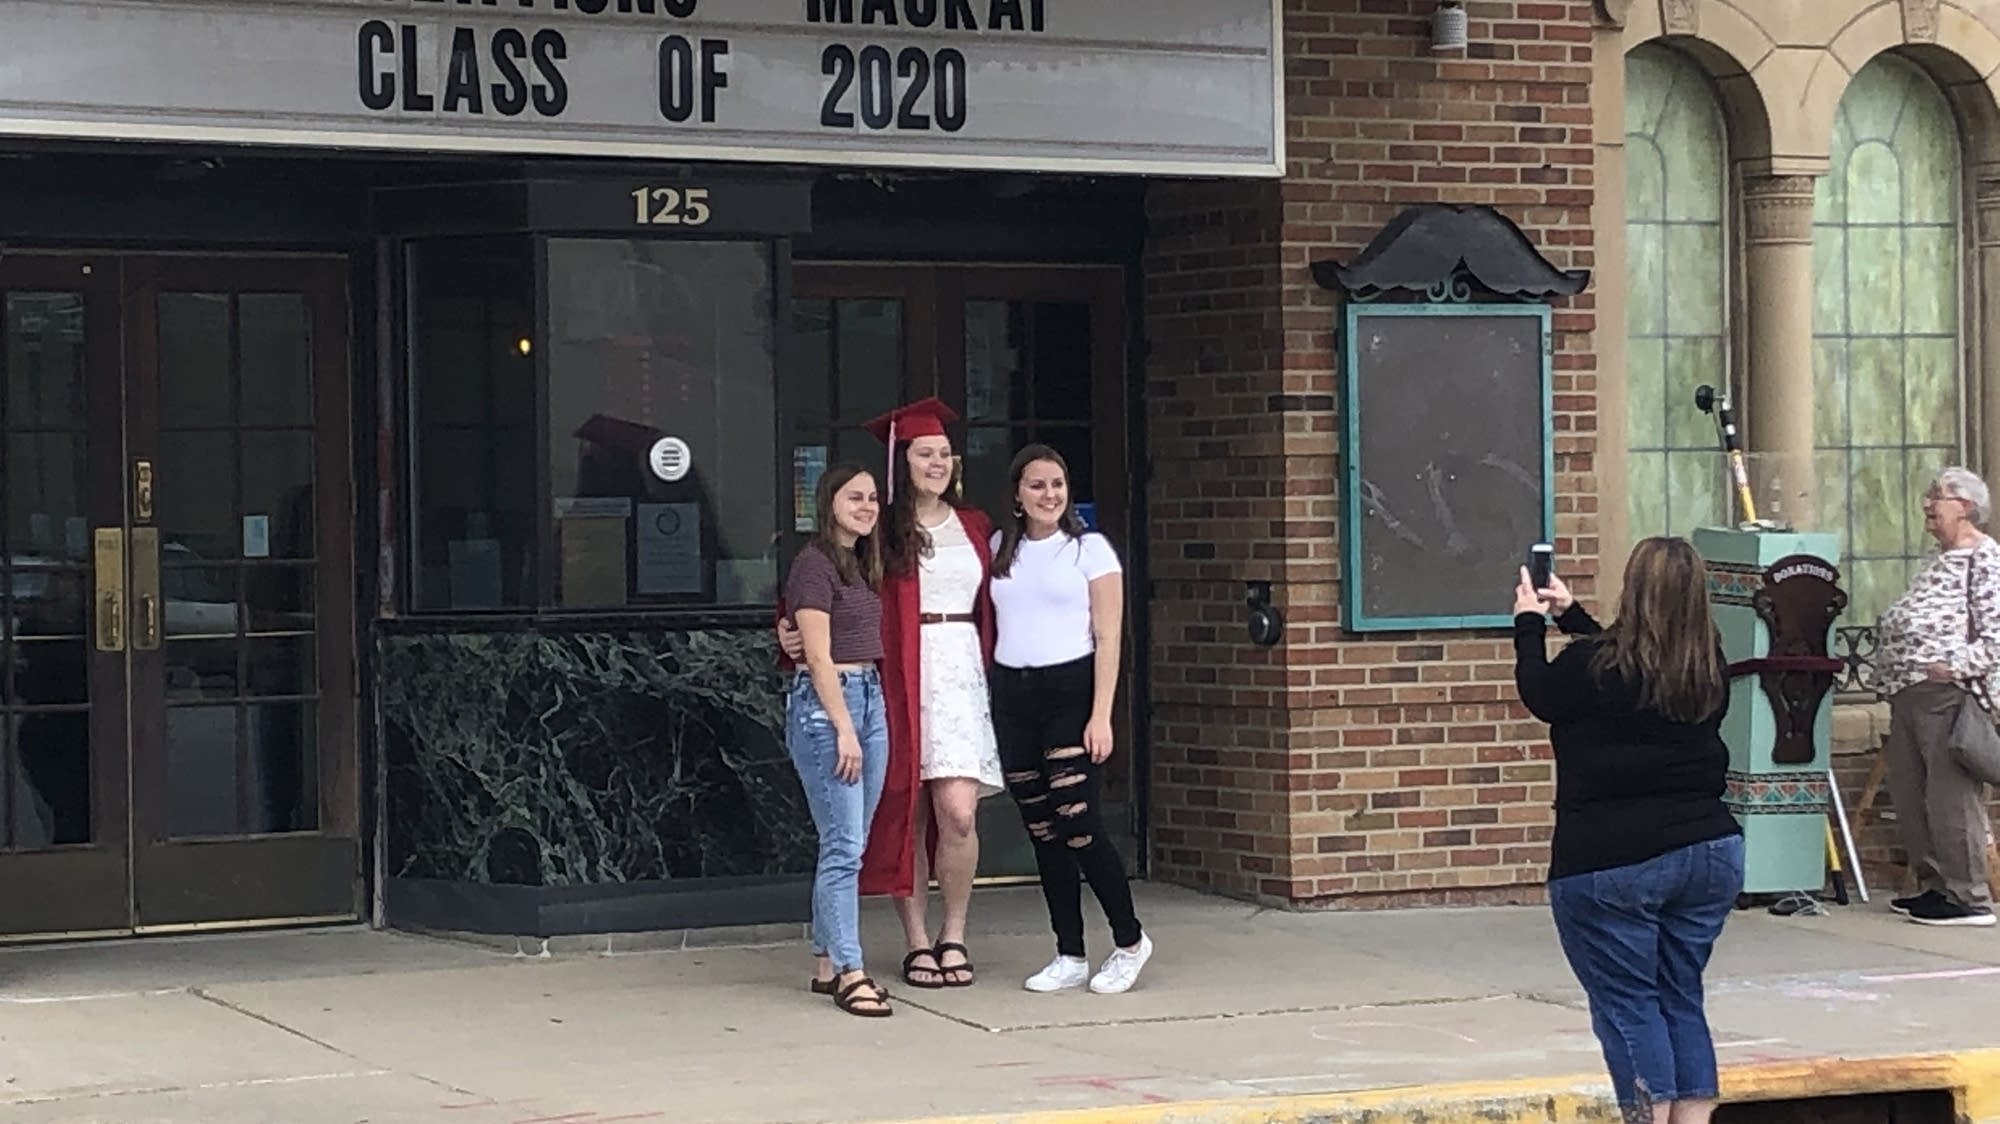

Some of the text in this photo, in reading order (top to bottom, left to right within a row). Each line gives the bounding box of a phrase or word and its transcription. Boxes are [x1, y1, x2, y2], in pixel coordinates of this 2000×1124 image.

[358, 19, 967, 132] CLASS OF 2020
[631, 186, 710, 225] 125
